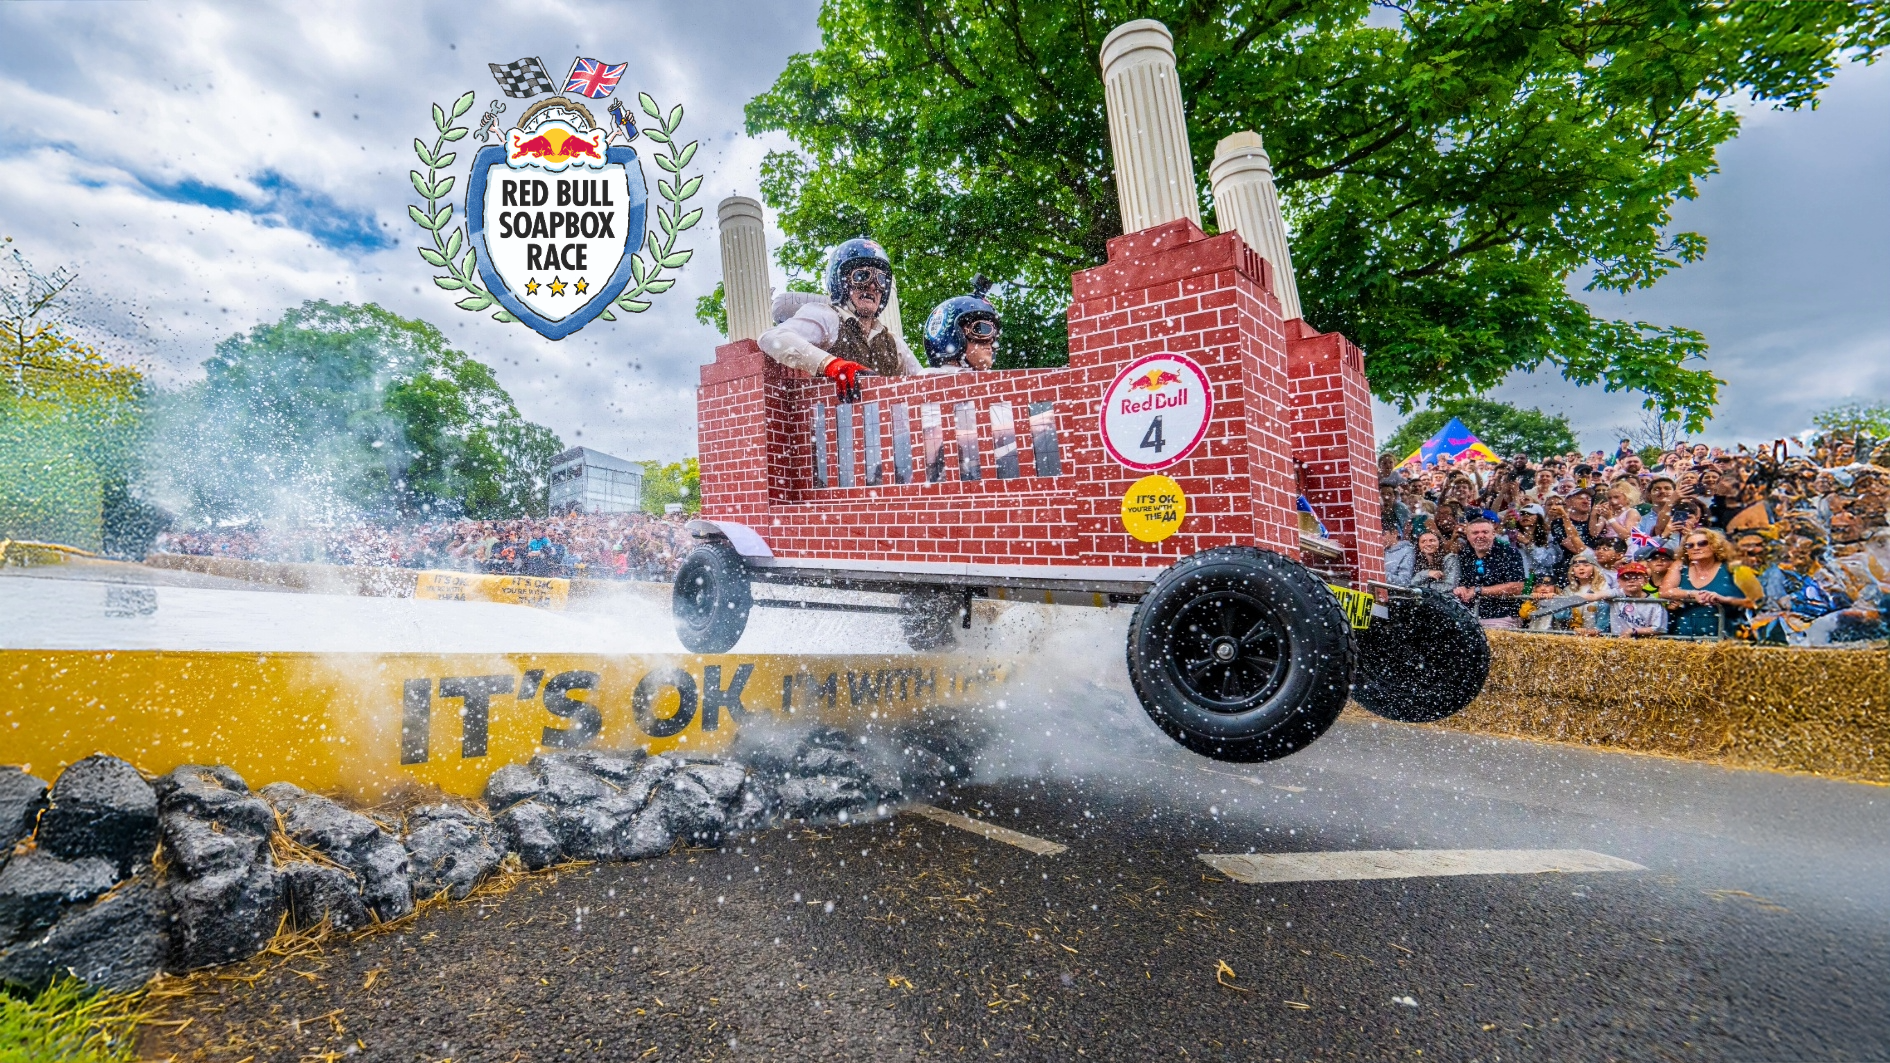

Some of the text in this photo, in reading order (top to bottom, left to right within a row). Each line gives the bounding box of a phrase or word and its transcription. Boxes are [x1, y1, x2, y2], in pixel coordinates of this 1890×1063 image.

[1121, 388, 1188, 415] Red Bull
[1139, 414, 1166, 453] 4
[1136, 494, 1179, 504] IT'S OK.
[1144, 510, 1177, 523] THE AA
[847, 666, 938, 706] WITH
[400, 663, 754, 766] IT'S OK
